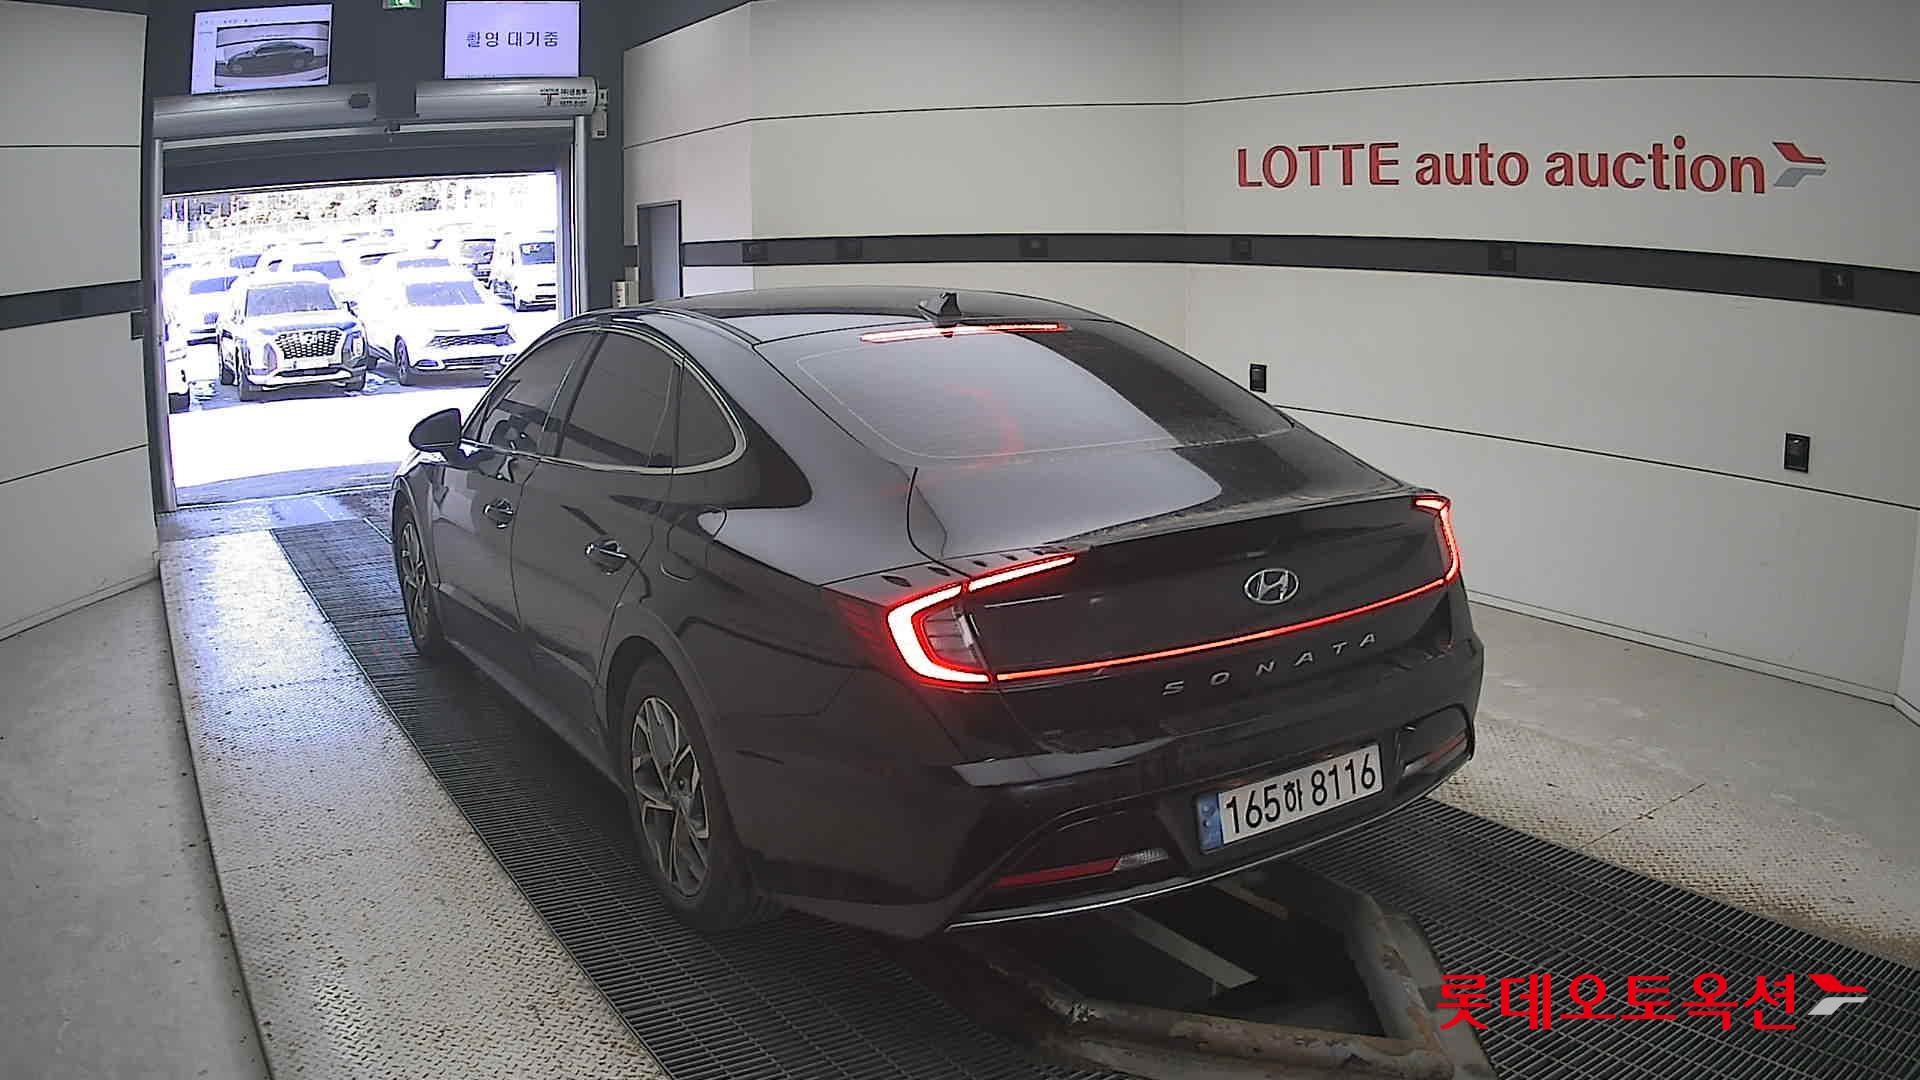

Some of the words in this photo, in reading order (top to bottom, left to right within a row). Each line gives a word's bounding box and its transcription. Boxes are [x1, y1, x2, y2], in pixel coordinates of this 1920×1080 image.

[507, 31, 559, 48] 대기중
[1238, 143, 1399, 188] LOTTE
[1416, 143, 1530, 187] auto
[1545, 137, 1767, 194] auction
[1162, 632, 1377, 696] SONATA
[1225, 777, 1305, 835] 165하
[1310, 752, 1378, 807] 8116
